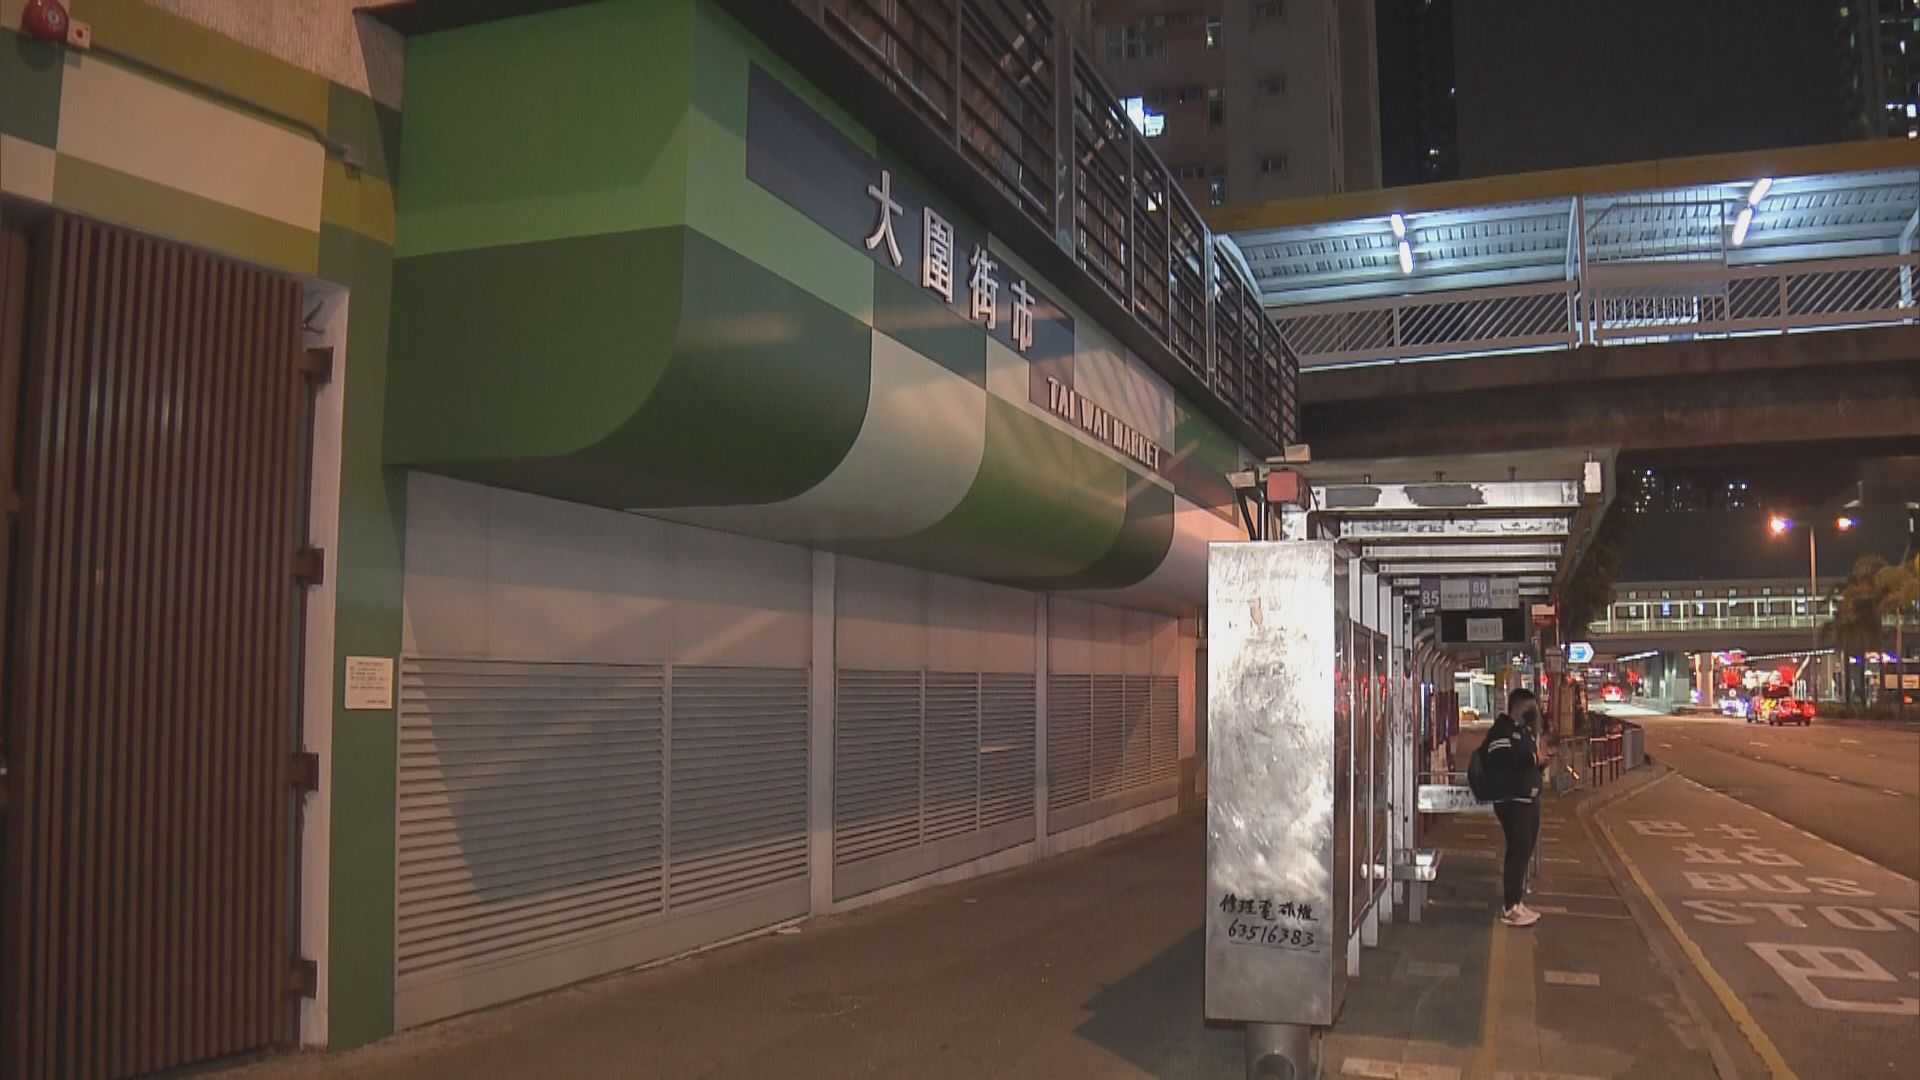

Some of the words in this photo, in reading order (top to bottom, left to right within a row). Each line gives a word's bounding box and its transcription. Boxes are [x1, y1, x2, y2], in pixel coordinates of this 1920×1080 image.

[865, 169, 1036, 351] 大圍街市
[1047, 376, 1076, 420] TAI
[1080, 398, 1108, 440] WAI
[1113, 418, 1161, 470] MARKET
[1422, 590, 1440, 605] 85
[1627, 819, 1760, 839] 巴士
[1682, 871, 1876, 896] BUS
[1228, 918, 1315, 948] 63516383
